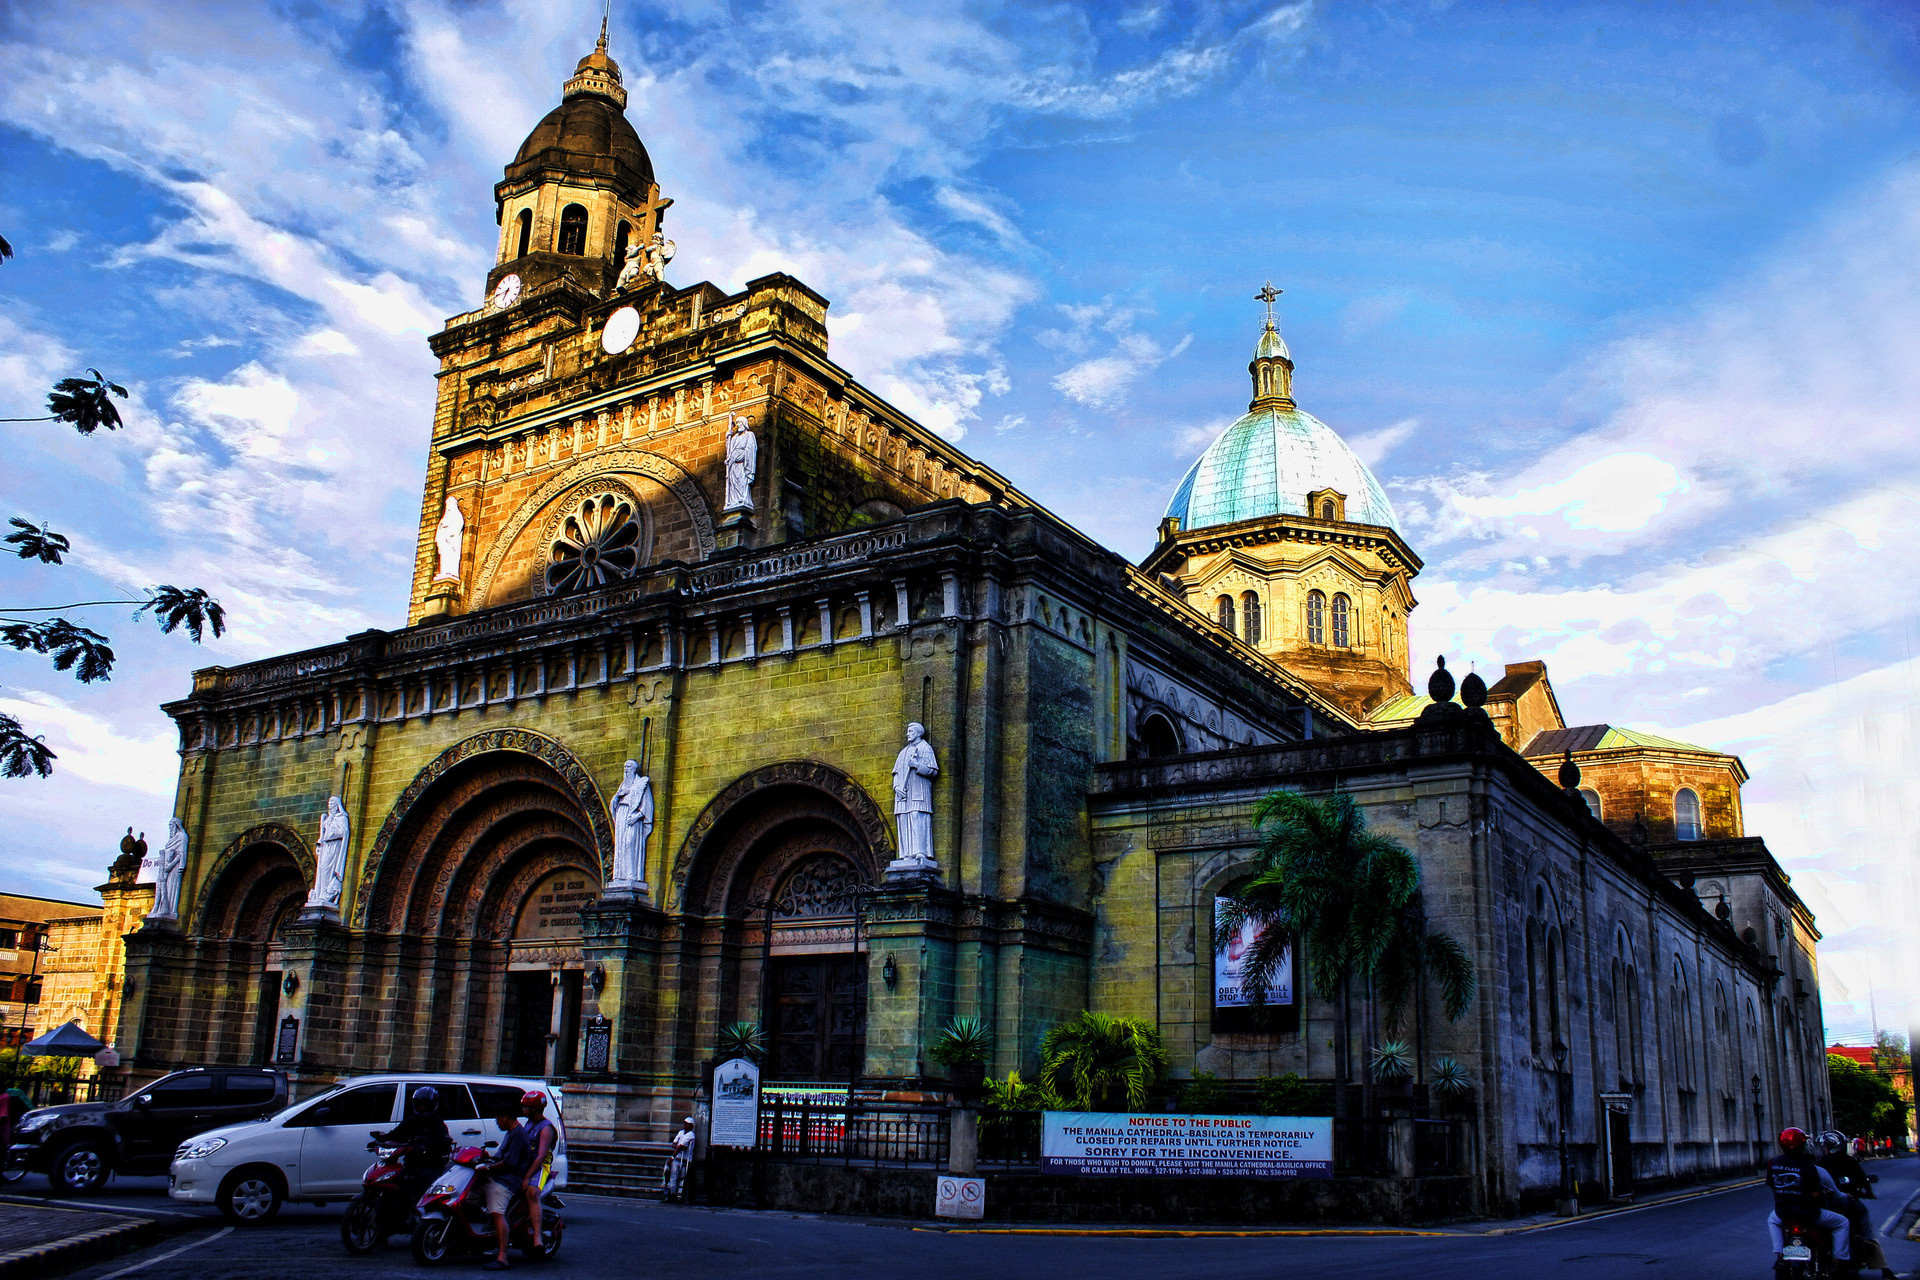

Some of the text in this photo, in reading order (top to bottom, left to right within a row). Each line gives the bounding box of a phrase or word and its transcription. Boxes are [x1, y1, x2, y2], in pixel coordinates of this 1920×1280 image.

[142, 859, 152, 868] Do
[1129, 1118, 1252, 1128] NOTICE TO THE PUBLIC
[1062, 1127, 1315, 1139] THE MANILA CATHEDRAL-BASILICA IS TEMPORARILY
[1075, 1136, 1115, 1144] CLOSED
[1140, 1138, 1182, 1146] REPAIRS
[1216, 1140, 1261, 1148] FURTHER
[1264, 1140, 1302, 1148] NOTICE.
[1085, 1147, 1293, 1160] SORRY FOR THE INCONVENIENCE.
[1050, 1158, 1063, 1166] FOR
[1064, 1158, 1086, 1166] THOSE
[1131, 1160, 1158, 1168] DONATE,
